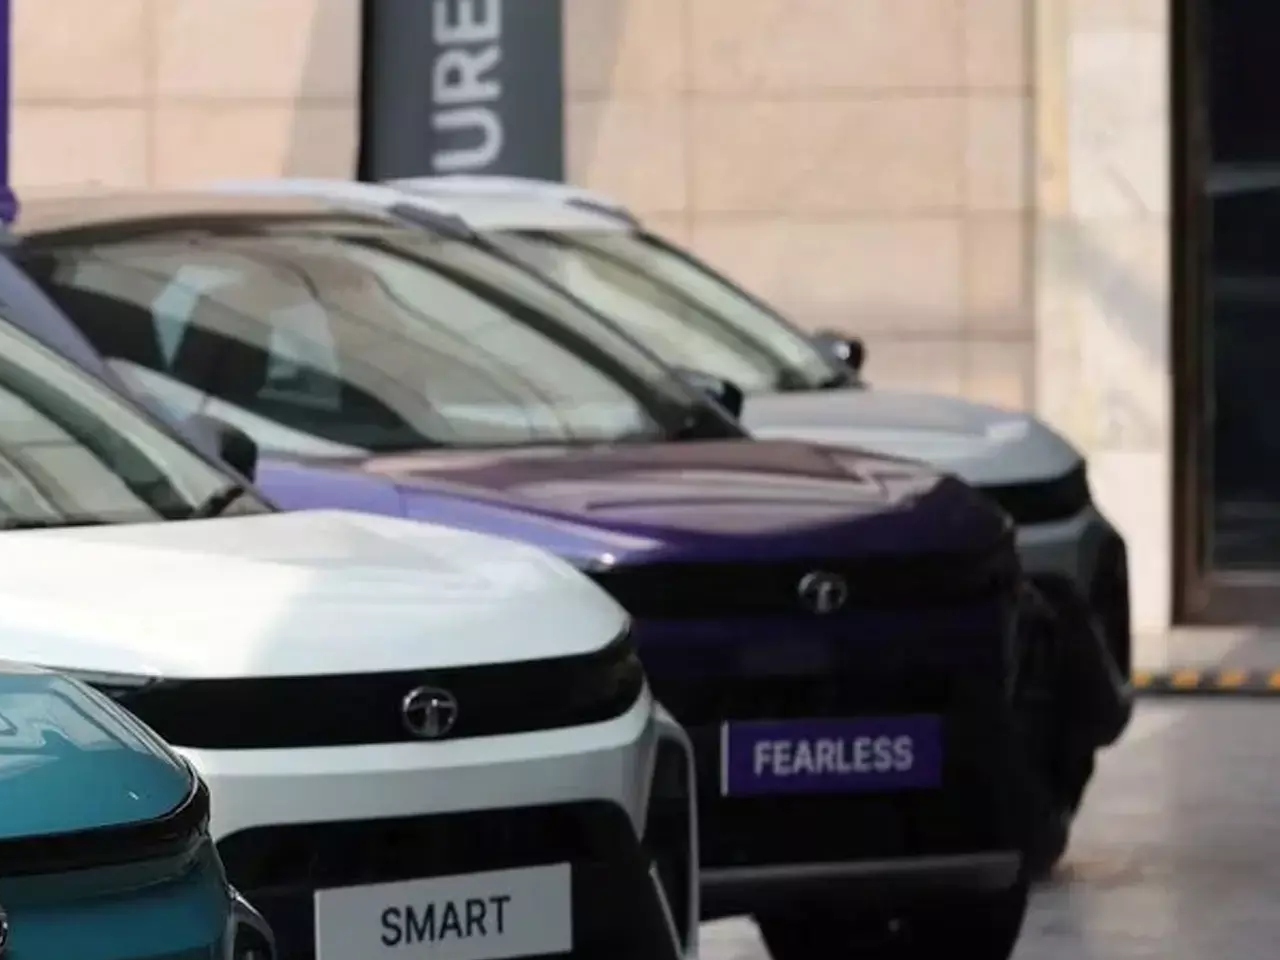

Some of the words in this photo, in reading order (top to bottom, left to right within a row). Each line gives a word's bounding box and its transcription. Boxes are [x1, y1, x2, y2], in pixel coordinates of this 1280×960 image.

[431, 0, 503, 172] URE
[753, 734, 915, 778] FEARLESS
[380, 894, 512, 947] SMART
